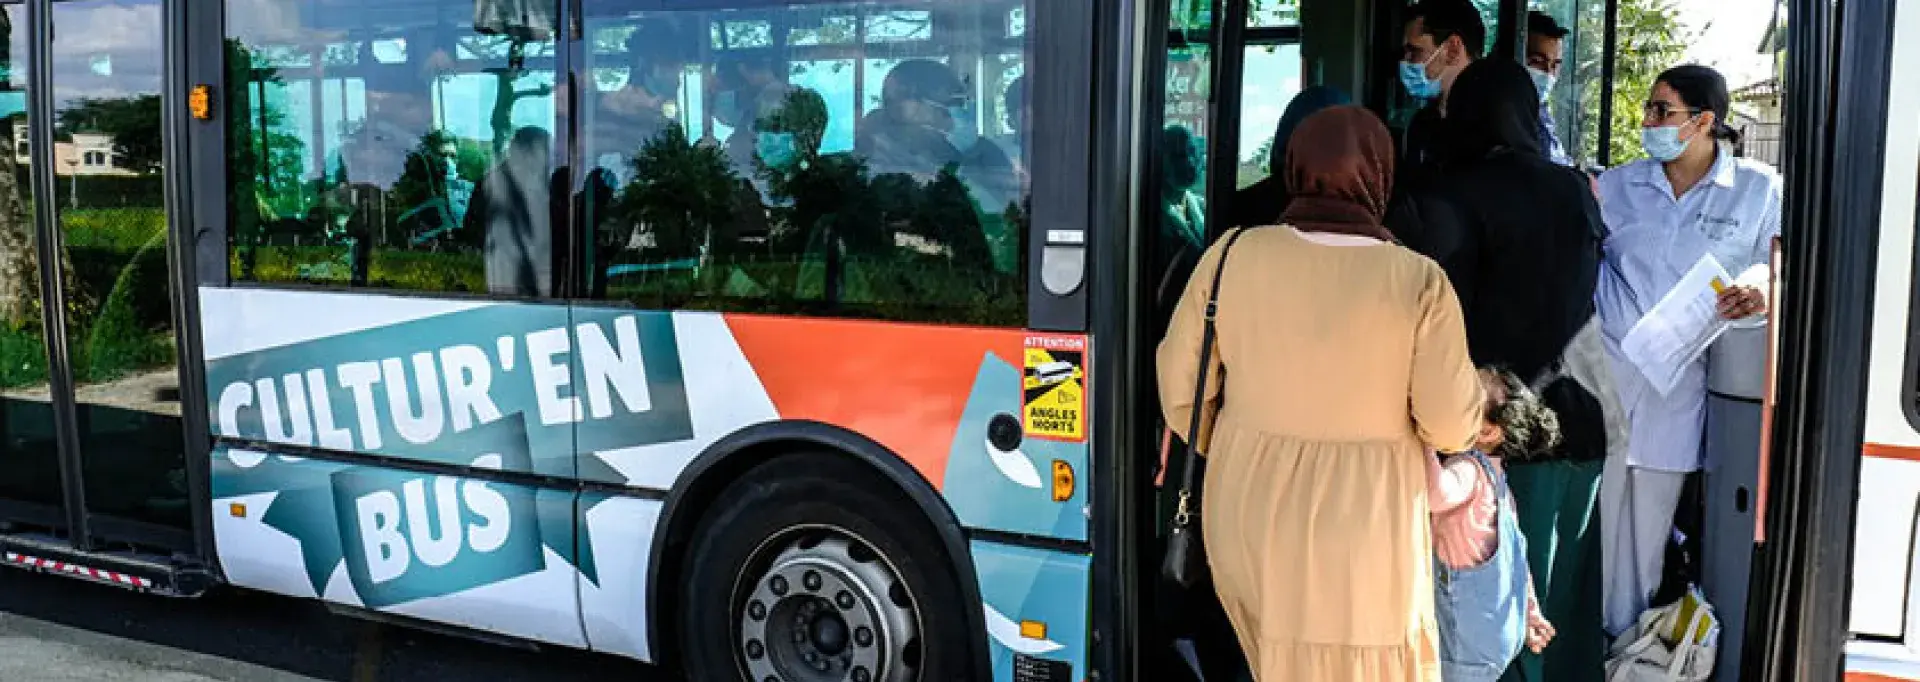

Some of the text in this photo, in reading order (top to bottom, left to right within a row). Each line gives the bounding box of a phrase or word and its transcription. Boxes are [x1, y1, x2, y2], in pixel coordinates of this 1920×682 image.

[1025, 336, 1083, 348] ATTENTION
[218, 315, 652, 468] CULTUR'EN
[1031, 407, 1077, 419] ANGLES
[1032, 420, 1075, 432] MORTS
[356, 453, 511, 584] BUS
